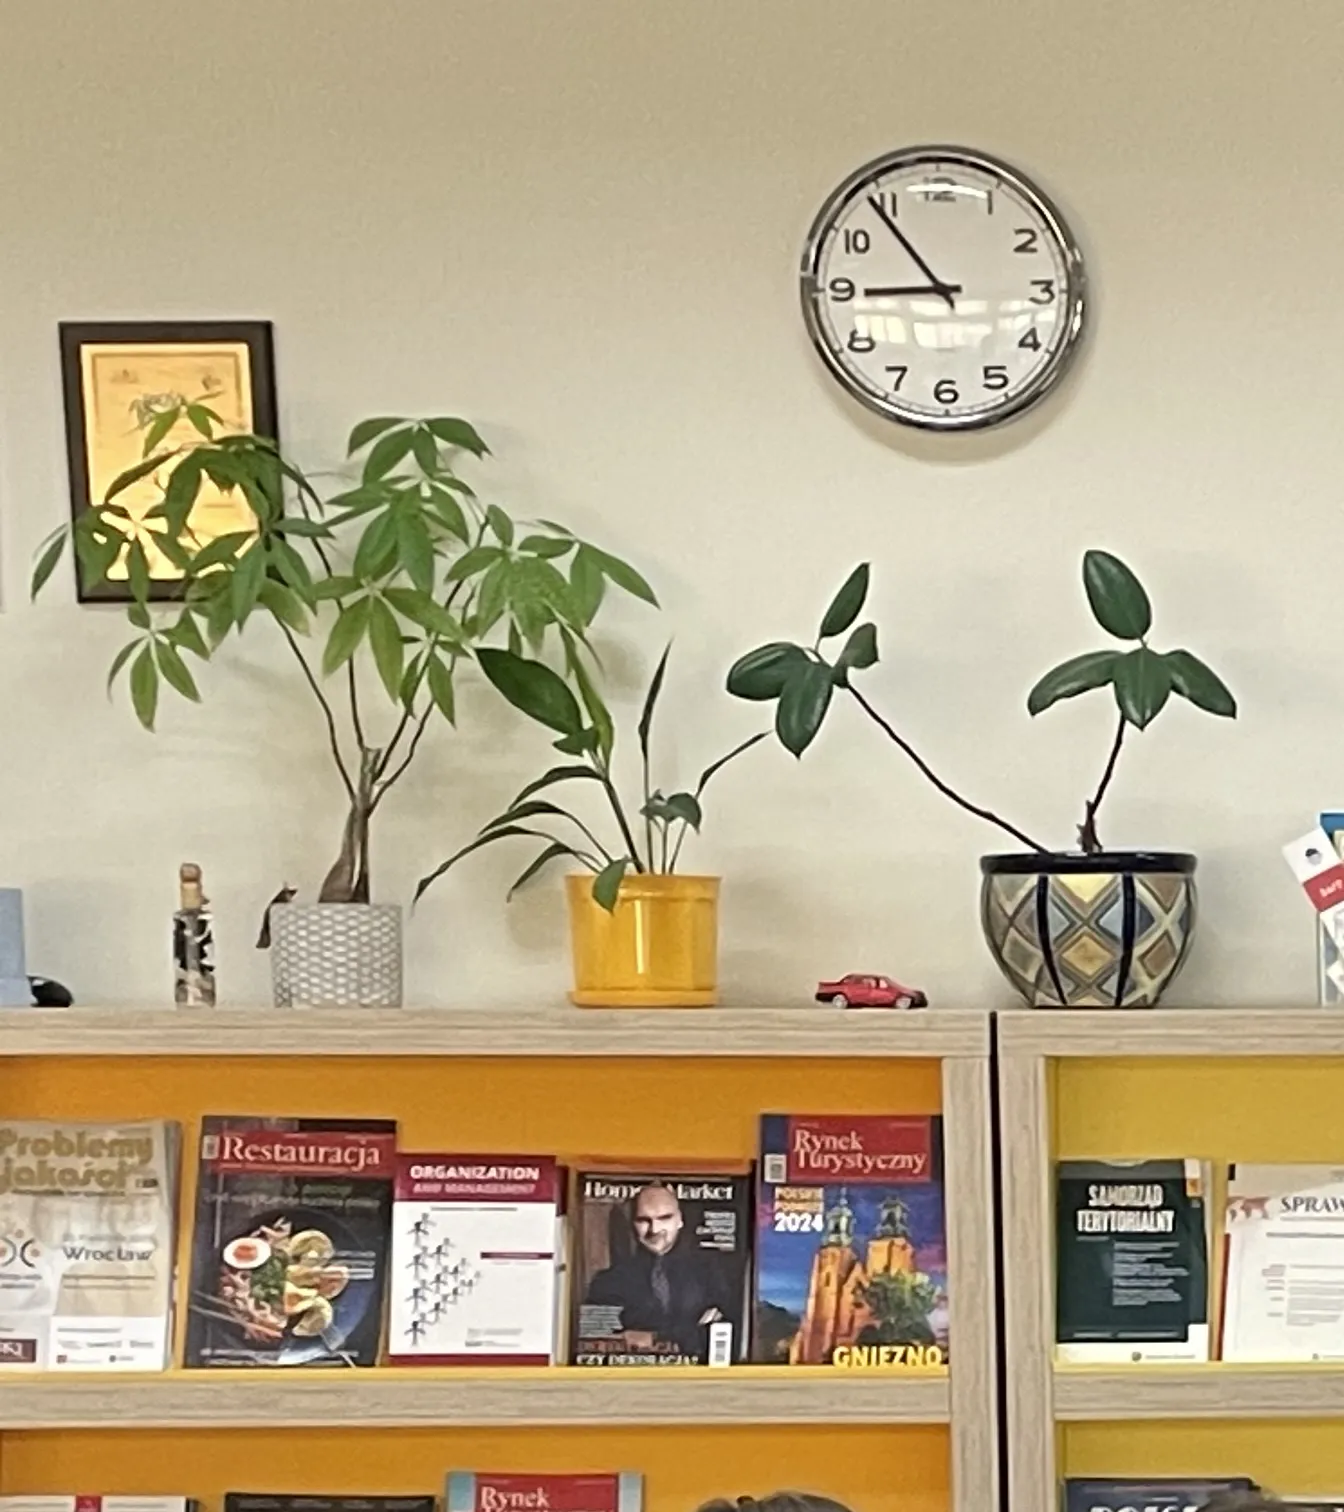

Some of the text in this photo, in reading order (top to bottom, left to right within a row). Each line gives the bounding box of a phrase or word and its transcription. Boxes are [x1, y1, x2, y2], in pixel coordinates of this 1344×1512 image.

[844, 229, 870, 254] 10
[1013, 228, 1038, 253] 2
[829, 277, 856, 302] 9
[1028, 279, 1055, 304] 3
[847, 328, 876, 353] 8
[1017, 327, 1042, 352] 4
[884, 365, 908, 391] 7
[982, 365, 1009, 390] 5
[933, 379, 959, 404] 6
[793, 1129, 864, 1153] Rynek
[222, 1136, 380, 1172] Restauracja
[798, 1150, 927, 1174] Turystyczny
[410, 1165, 541, 1180] ORGANIZATION
[774, 1212, 824, 1232] 2024
[833, 1346, 942, 1368] GNIEZNO
[481, 1486, 549, 1509] Rynek
